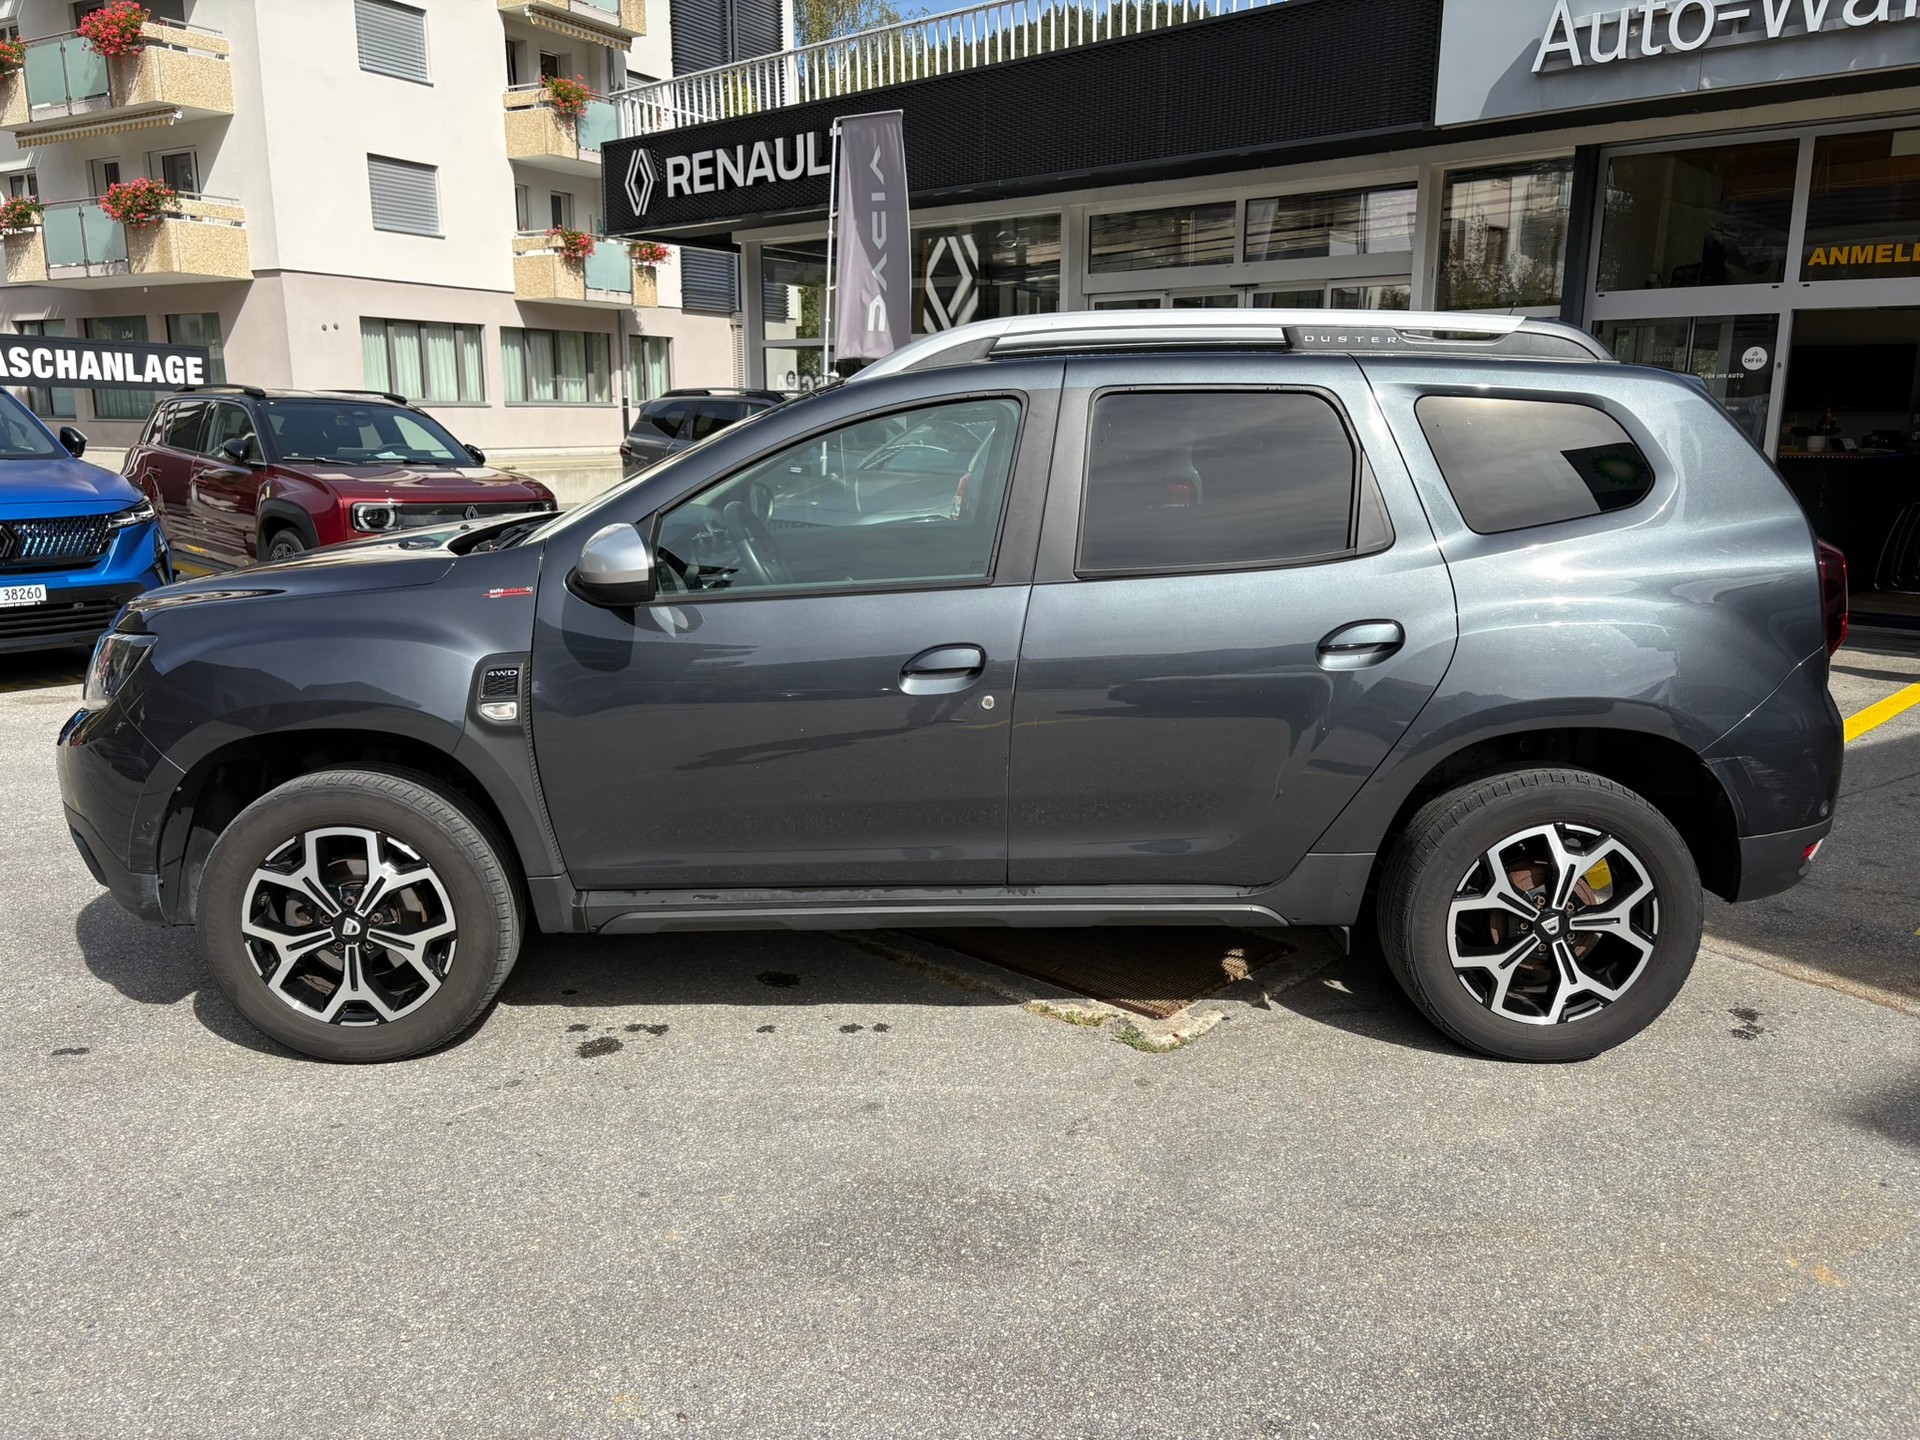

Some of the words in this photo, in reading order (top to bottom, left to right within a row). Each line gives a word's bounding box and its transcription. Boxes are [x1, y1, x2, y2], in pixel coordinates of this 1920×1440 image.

[1531, 0, 1920, 73] Auto-
[867, 144, 887, 331] DACIA
[1304, 335, 1396, 344] DUSTER
[3, 587, 42, 601] 38260
[486, 669, 518, 677] 4WD
